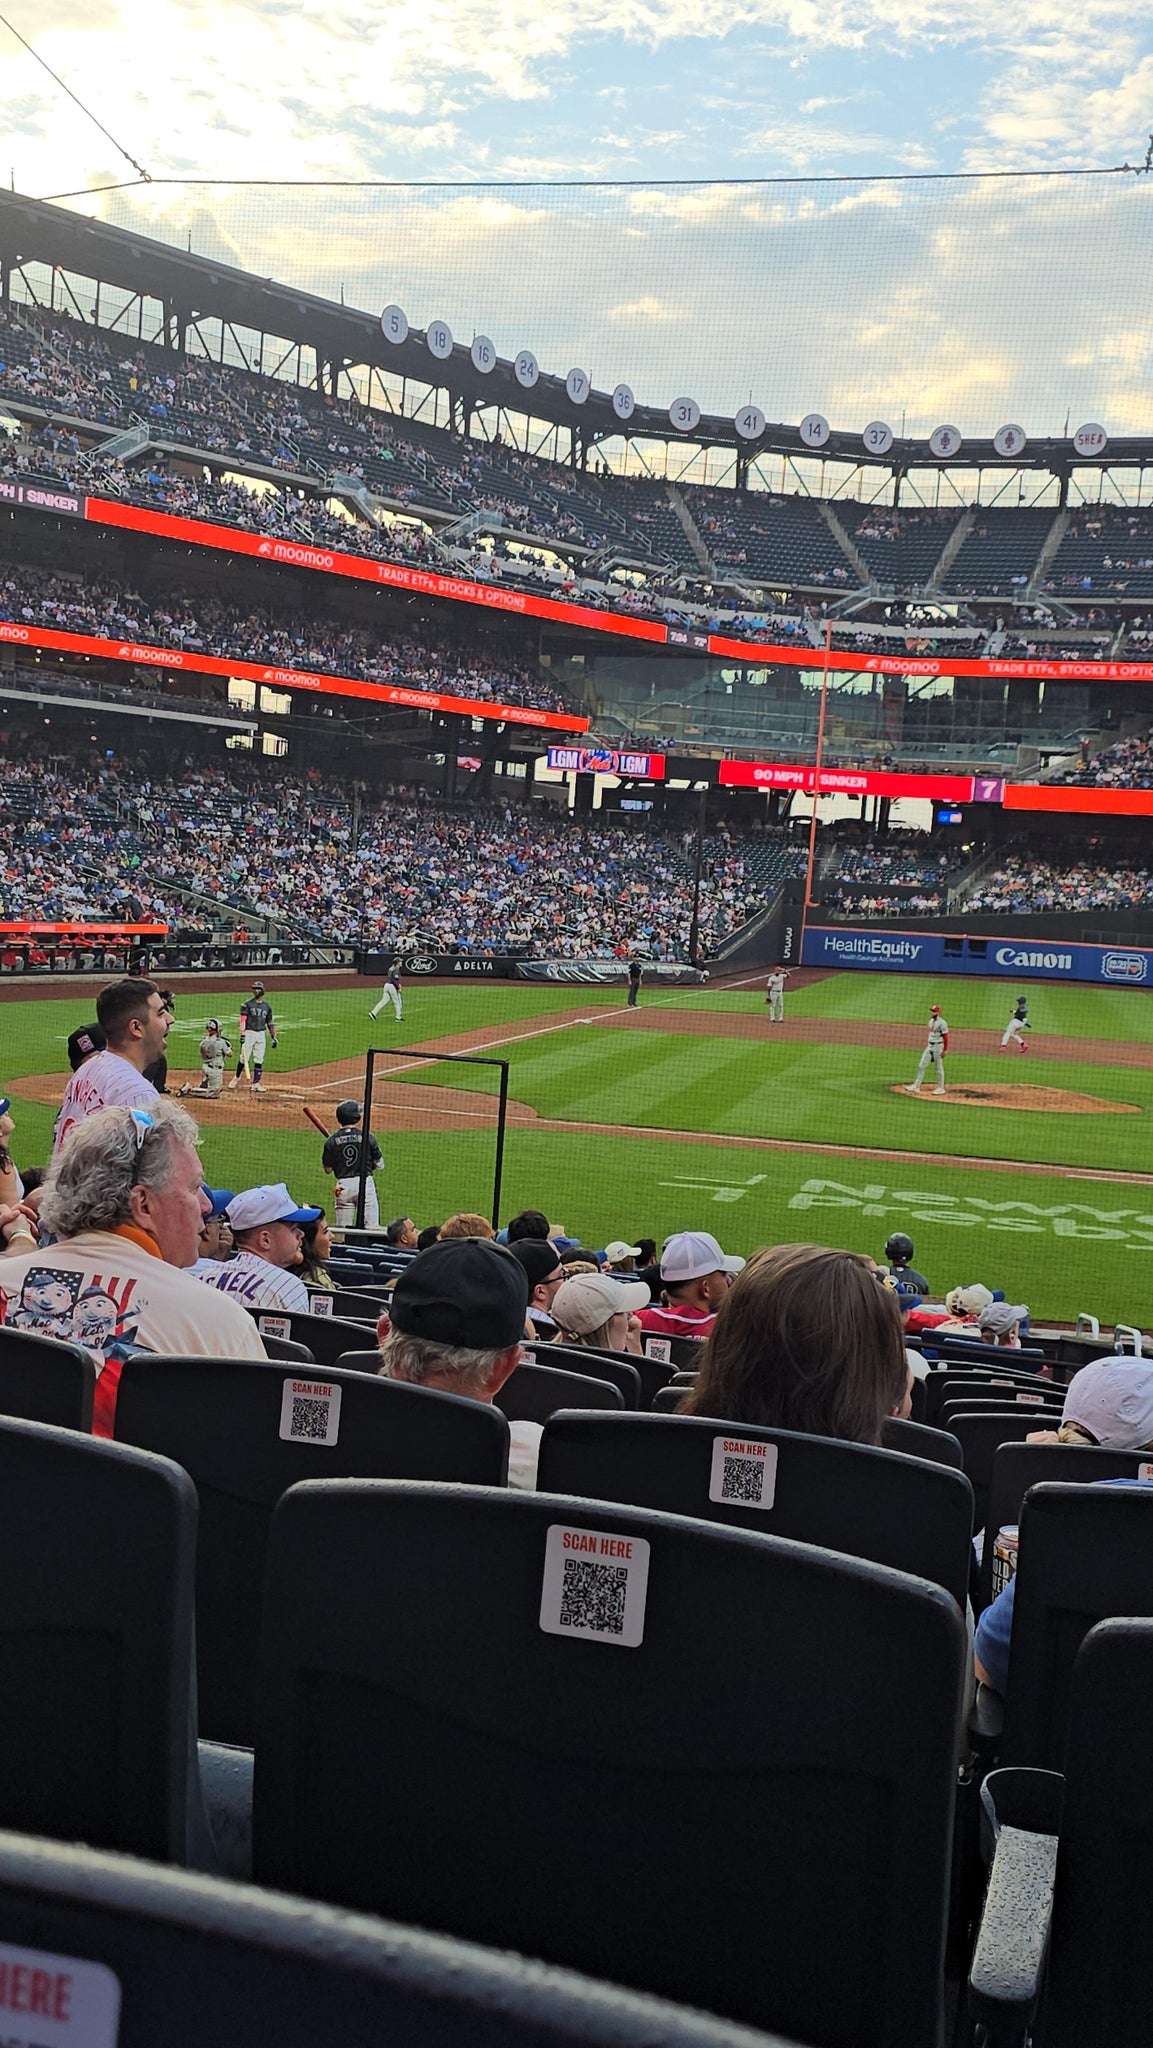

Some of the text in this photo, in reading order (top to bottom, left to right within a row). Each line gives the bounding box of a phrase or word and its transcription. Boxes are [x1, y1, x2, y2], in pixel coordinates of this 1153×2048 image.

[391, 316, 399, 333] 5
[434, 330, 446, 348] 18
[479, 345, 489, 363] 16
[520, 361, 534, 378] 24
[572, 378, 583, 394] 17
[617, 394, 630, 410] 36
[678, 407, 691, 421] 31
[743, 416, 757, 430] 41
[808, 423, 821, 437] 14
[870, 431, 886, 445] 37
[1078, 433, 1103, 445] SHEA
[26, 490, 78, 512] SINKER
[274, 544, 333, 568] moomoo
[378, 566, 525, 609] TRADE ETFs, STOCKS & OPTIONS
[132, 648, 183, 665] moomoo
[880, 660, 940, 673] moomoo
[989, 662, 1025, 674] TRADE
[1059, 664, 1108, 676] STOCKS
[1110, 665, 1118, 677] &
[275, 671, 320, 688] moomoo
[399, 692, 440, 707] moomoo
[510, 710, 546, 723] moomoo
[551, 749, 579, 769] LGM
[620, 754, 647, 774] LGM
[754, 768, 772, 781] 90
[773, 770, 804, 784] MPH
[820, 774, 867, 789] SINKER
[981, 780, 998, 799] 7
[824, 936, 920, 959] HealthEquity
[411, 957, 433, 970] Ford
[464, 961, 493, 970] DELTA
[996, 948, 1072, 970] Canon
[343, 1144, 359, 1167] 9
[292, 1382, 333, 1397] SCAN HERE
[723, 1440, 767, 1457] SCAN HERE
[563, 1532, 633, 1559] SCAN HERE
